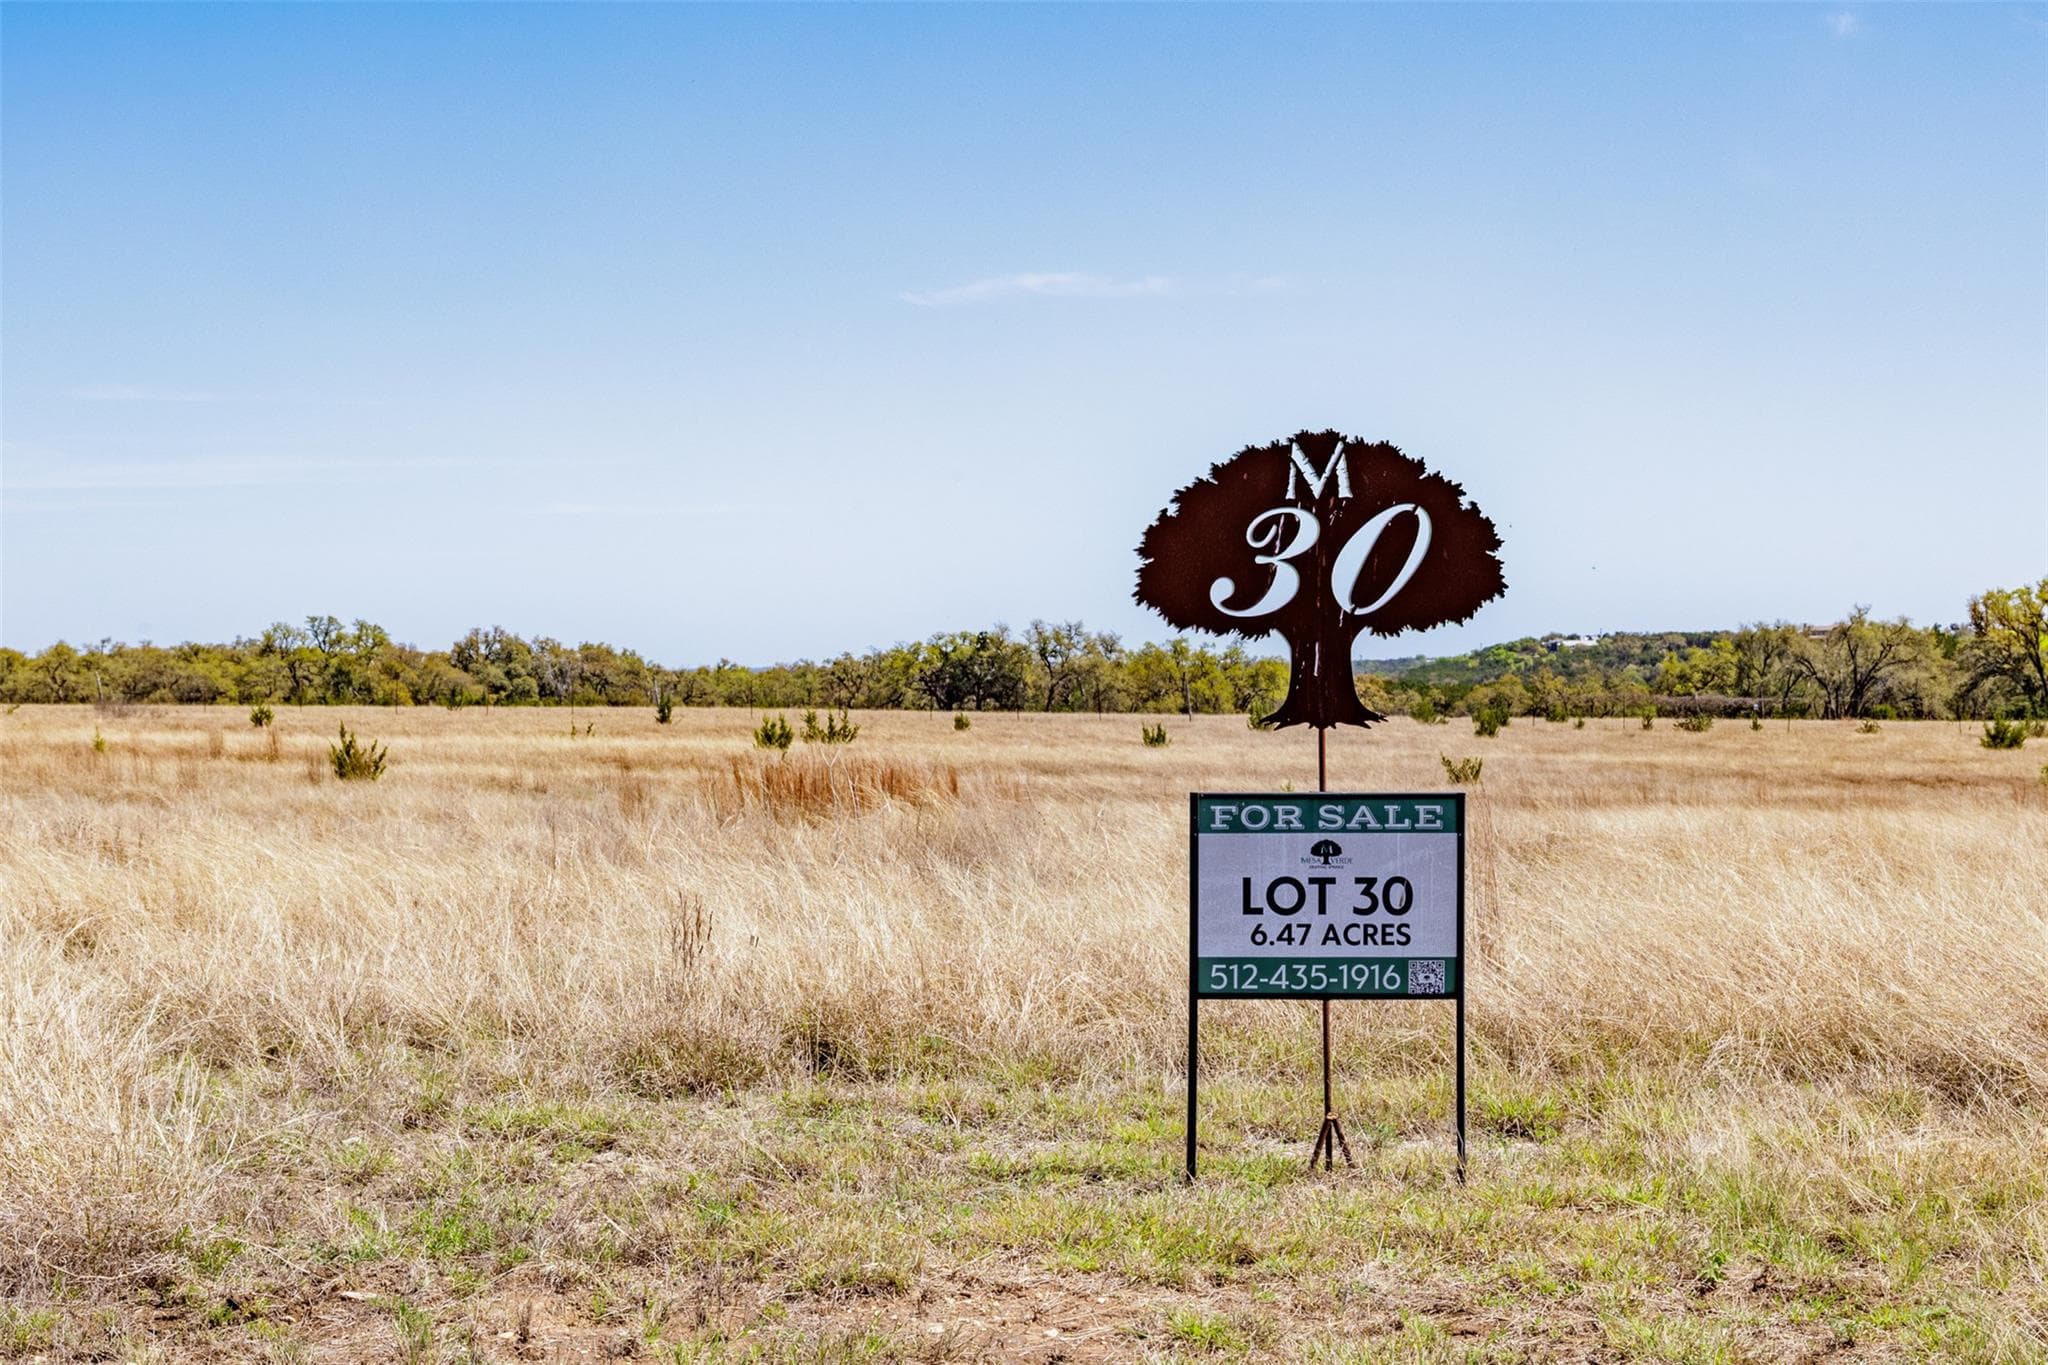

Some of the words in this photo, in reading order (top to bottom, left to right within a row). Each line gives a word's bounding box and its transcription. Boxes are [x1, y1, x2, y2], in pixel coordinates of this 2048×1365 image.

[1285, 441, 1353, 499] M
[1210, 503, 1433, 617] 30
[1210, 804, 1305, 830] FOR
[1317, 804, 1445, 830] SALE
[1242, 876, 1336, 916] LOT
[1353, 876, 1413, 916] 30
[1250, 923, 1312, 946] 6.47
[1321, 923, 1411, 946] ACRES
[1210, 964, 1401, 990] 512-435-1916
